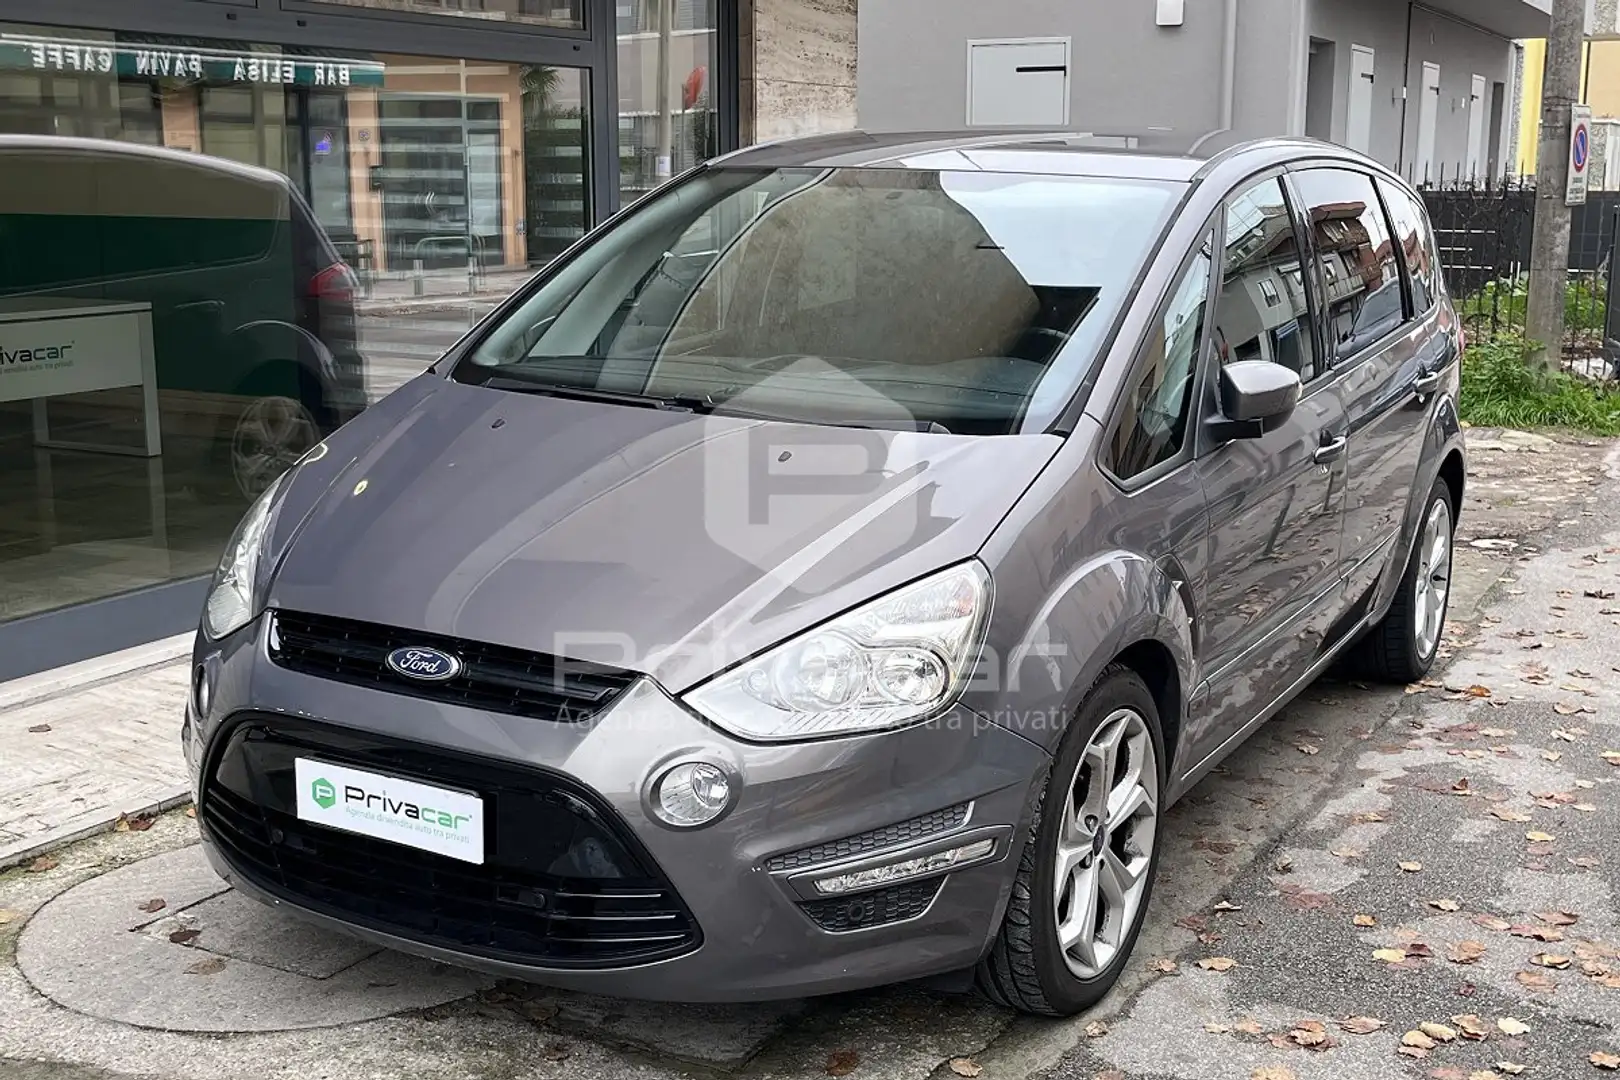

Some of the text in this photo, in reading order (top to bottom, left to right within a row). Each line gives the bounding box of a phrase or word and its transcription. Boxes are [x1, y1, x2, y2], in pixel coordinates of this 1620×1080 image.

[400, 651, 441, 673] Ford
[344, 785, 470, 829] Privacar
[414, 825, 432, 835] auto
[433, 828, 444, 837] tra
[445, 832, 470, 844] privati
